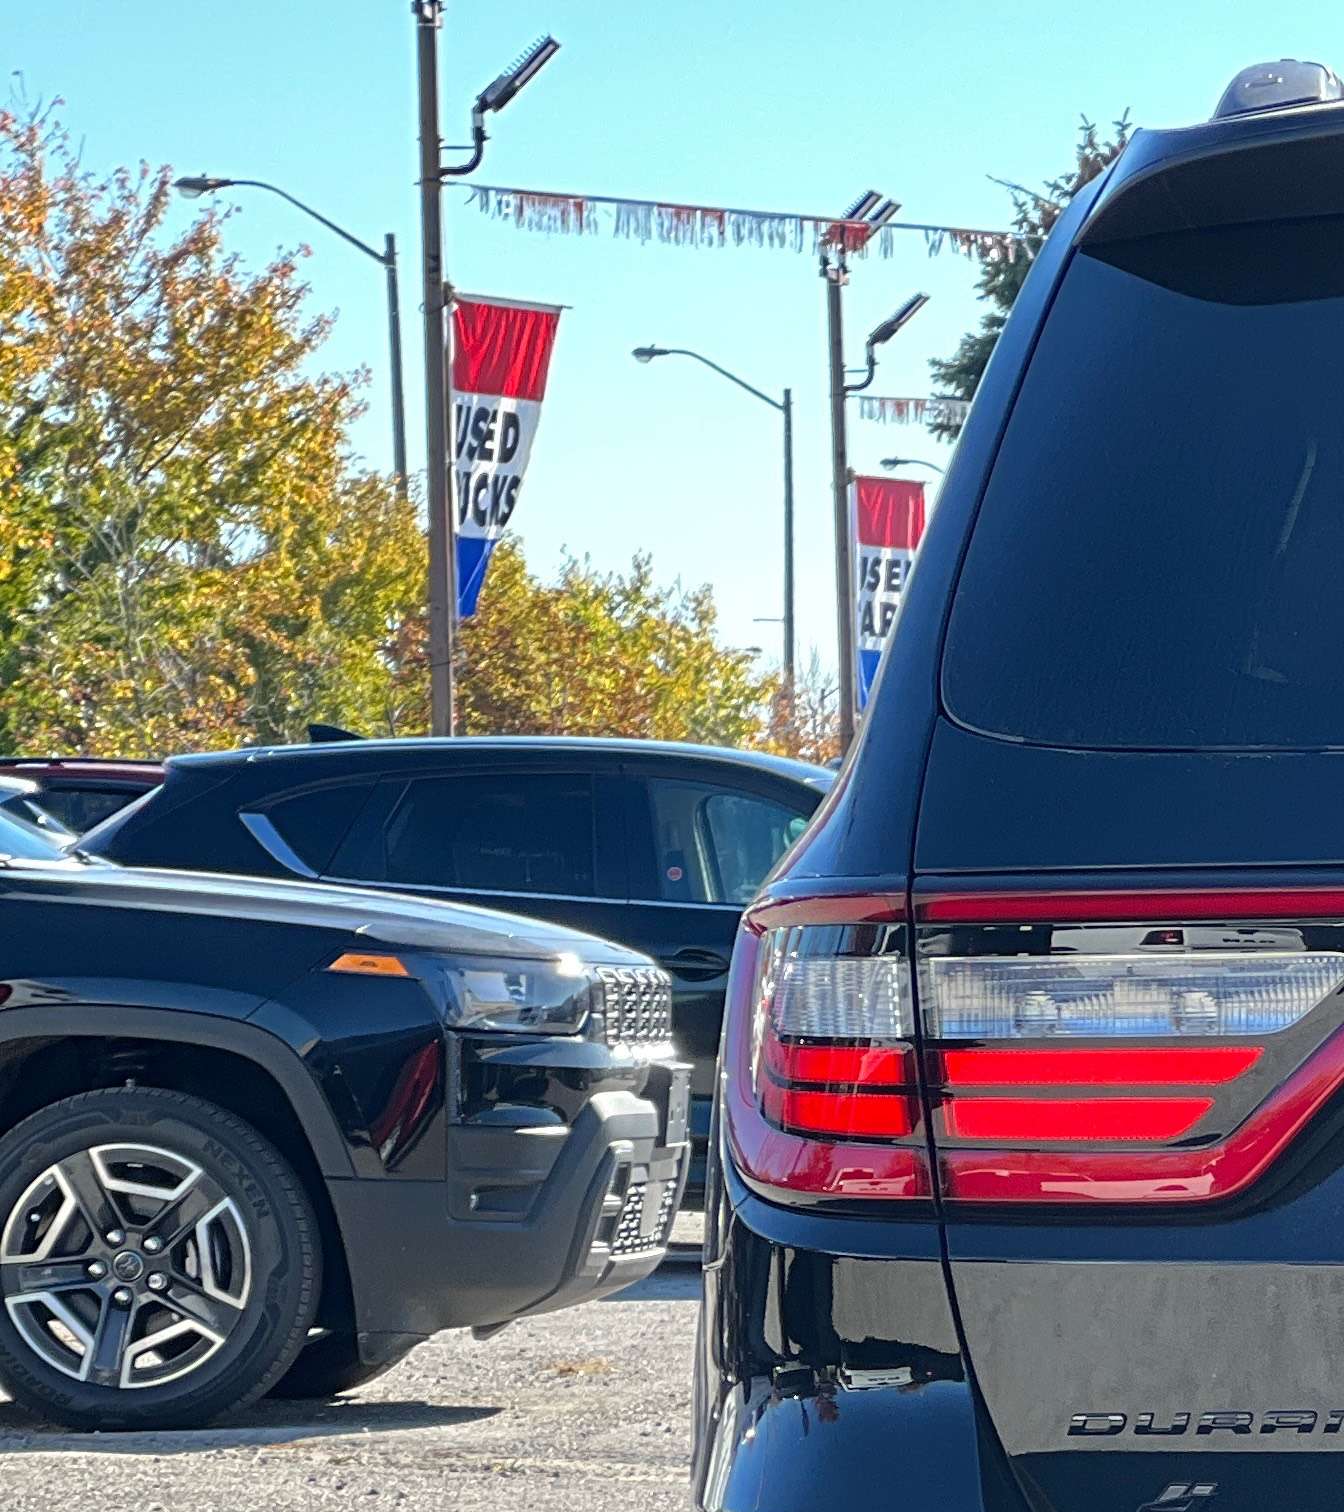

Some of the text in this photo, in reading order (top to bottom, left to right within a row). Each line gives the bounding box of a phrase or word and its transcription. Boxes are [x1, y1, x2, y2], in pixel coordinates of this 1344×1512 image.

[456, 404, 520, 463] USED
[456, 470, 520, 527] UCKS
[858, 600, 899, 638] AR
[203, 1139, 270, 1219] NEXEN
